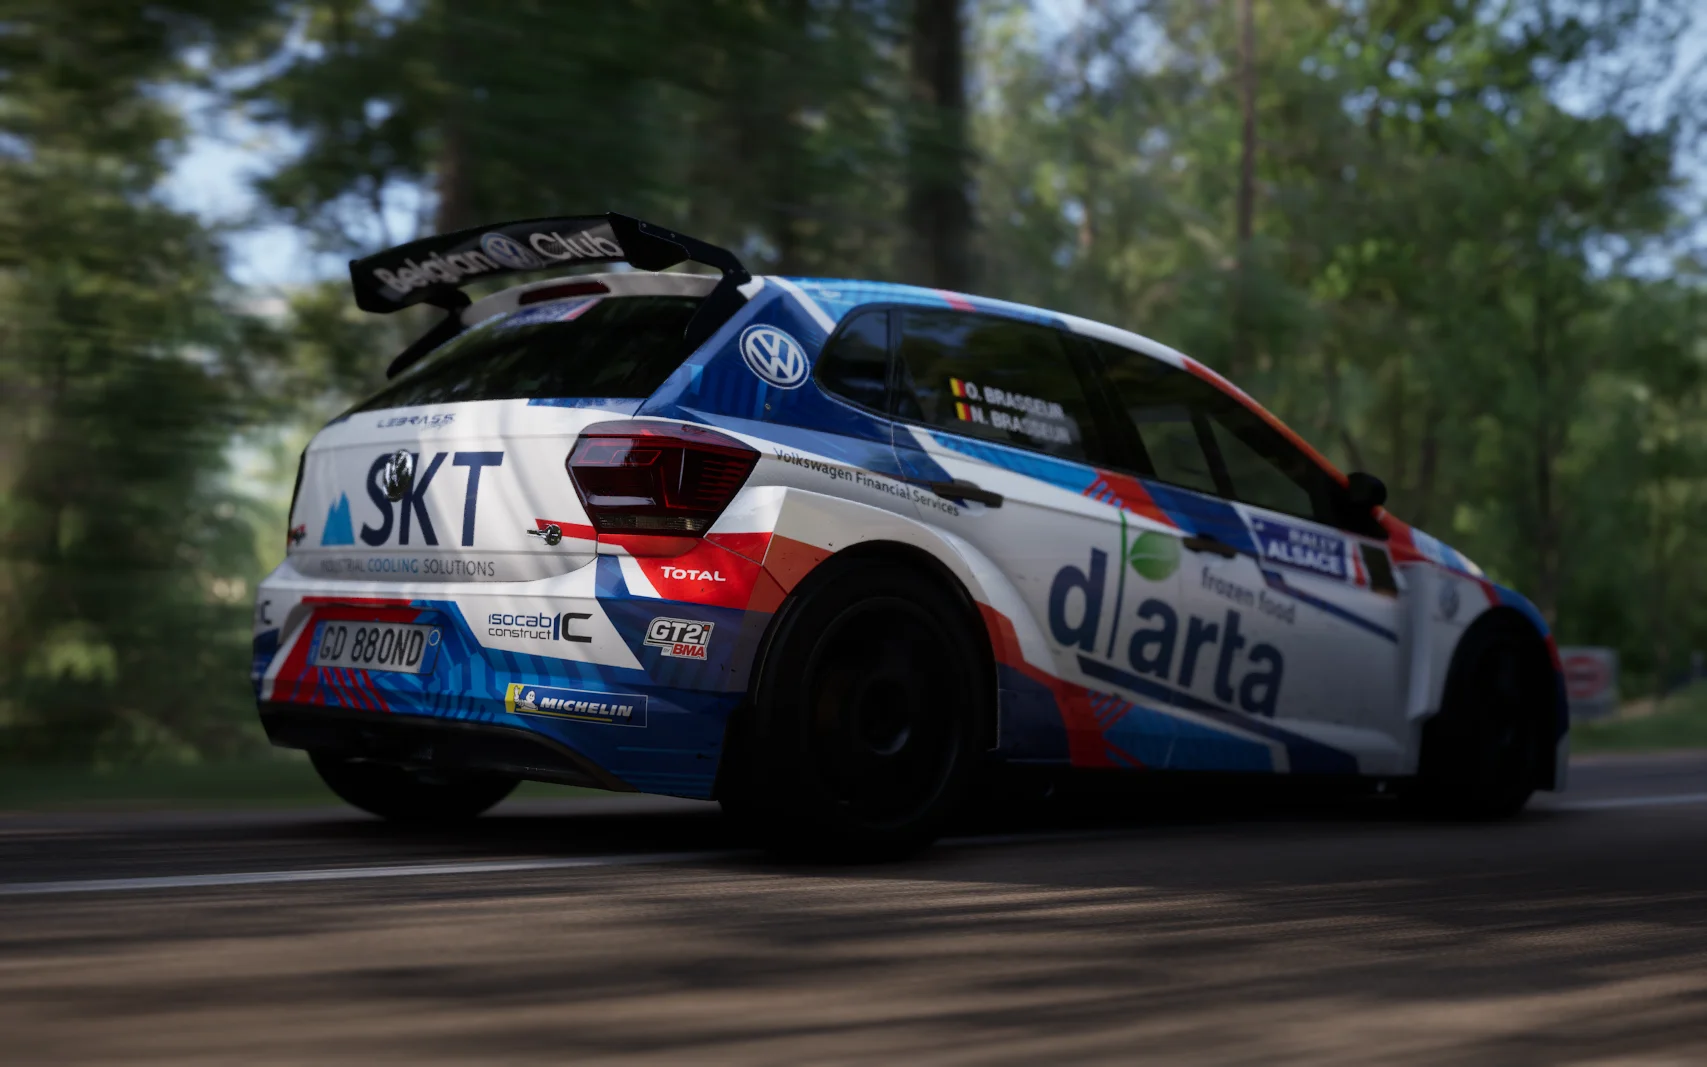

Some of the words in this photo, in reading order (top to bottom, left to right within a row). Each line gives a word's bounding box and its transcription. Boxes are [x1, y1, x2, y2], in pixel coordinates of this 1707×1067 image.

[372, 250, 500, 294] Belgian
[529, 231, 625, 260] Club
[983, 385, 1065, 419] BRASSEUR
[774, 448, 853, 483] Volkswagen
[855, 471, 911, 500] Financial
[912, 489, 960, 517] Services
[360, 451, 505, 547] SKT
[367, 558, 419, 574] COOLING
[423, 559, 496, 577] SOLUTIONS
[1267, 539, 1343, 577] ALSACE
[661, 566, 726, 582] TOTAL
[1202, 566, 1255, 608] frozen
[488, 612, 552, 628] isocab
[488, 627, 552, 641] construct
[650, 620, 711, 645] GT2i
[320, 626, 348, 660] GD
[672, 643, 705, 658] BMA
[540, 697, 634, 718] MICHELIN
